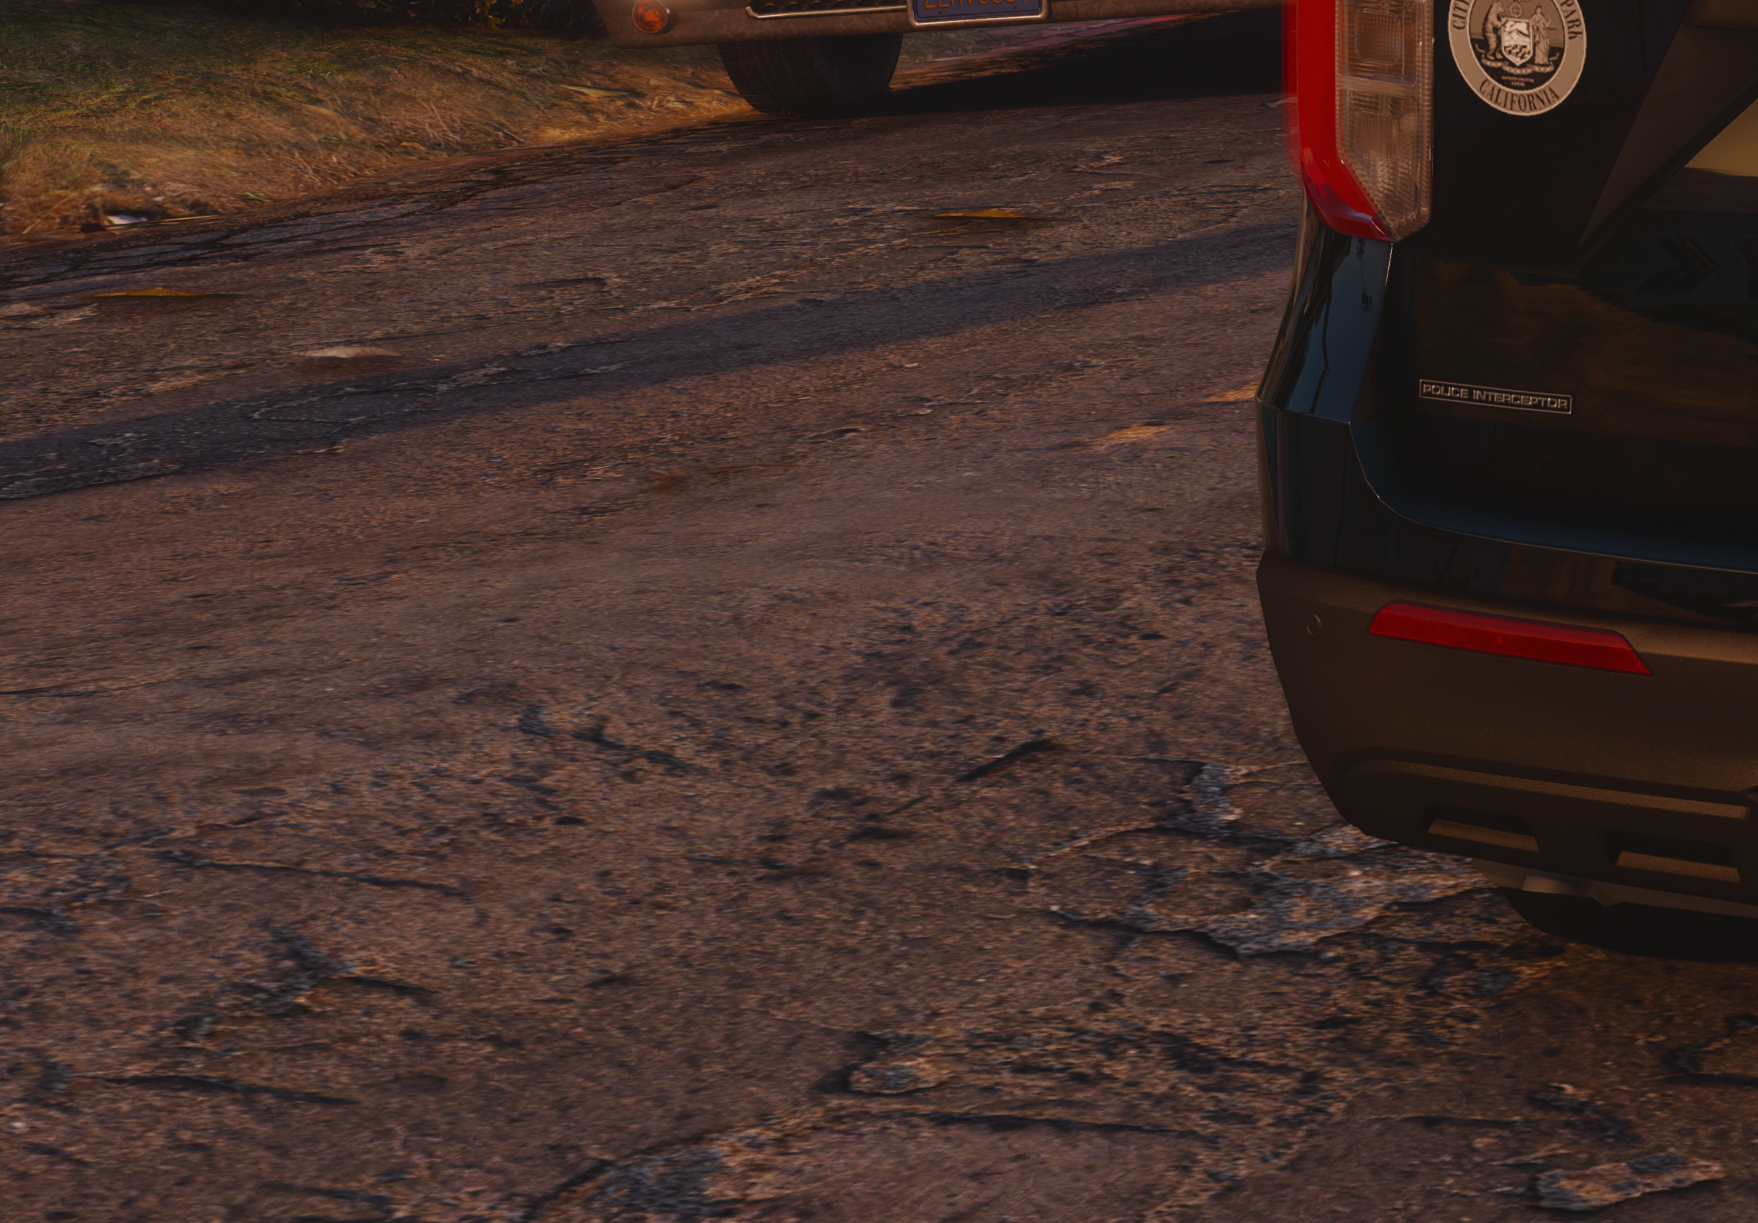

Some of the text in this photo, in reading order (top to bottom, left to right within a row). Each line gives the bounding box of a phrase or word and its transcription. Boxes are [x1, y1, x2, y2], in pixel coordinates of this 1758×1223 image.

[1480, 78, 1560, 112] CALIFORNIA
[1422, 382, 1569, 409] POLICE INTERCEPTOR
